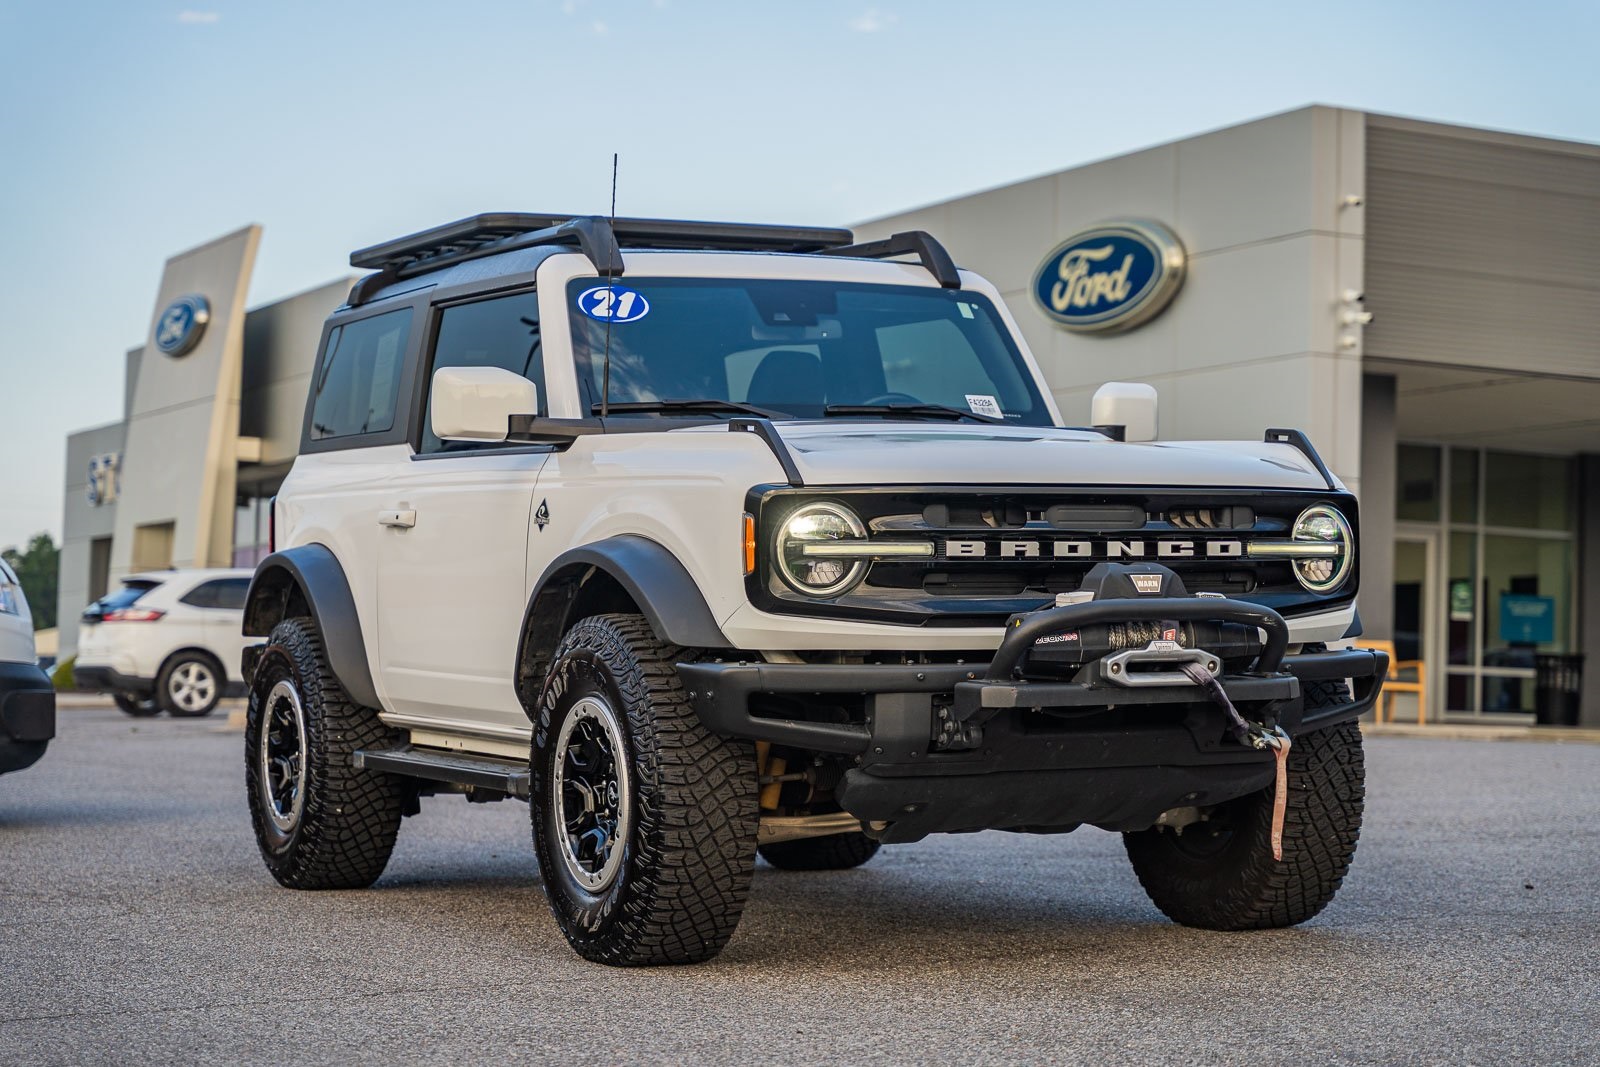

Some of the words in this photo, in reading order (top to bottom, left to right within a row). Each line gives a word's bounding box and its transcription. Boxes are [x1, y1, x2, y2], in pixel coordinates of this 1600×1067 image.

[1051, 244, 1134, 312] Ford
[591, 289, 636, 318] 21
[946, 540, 1241, 558] BRONCO
